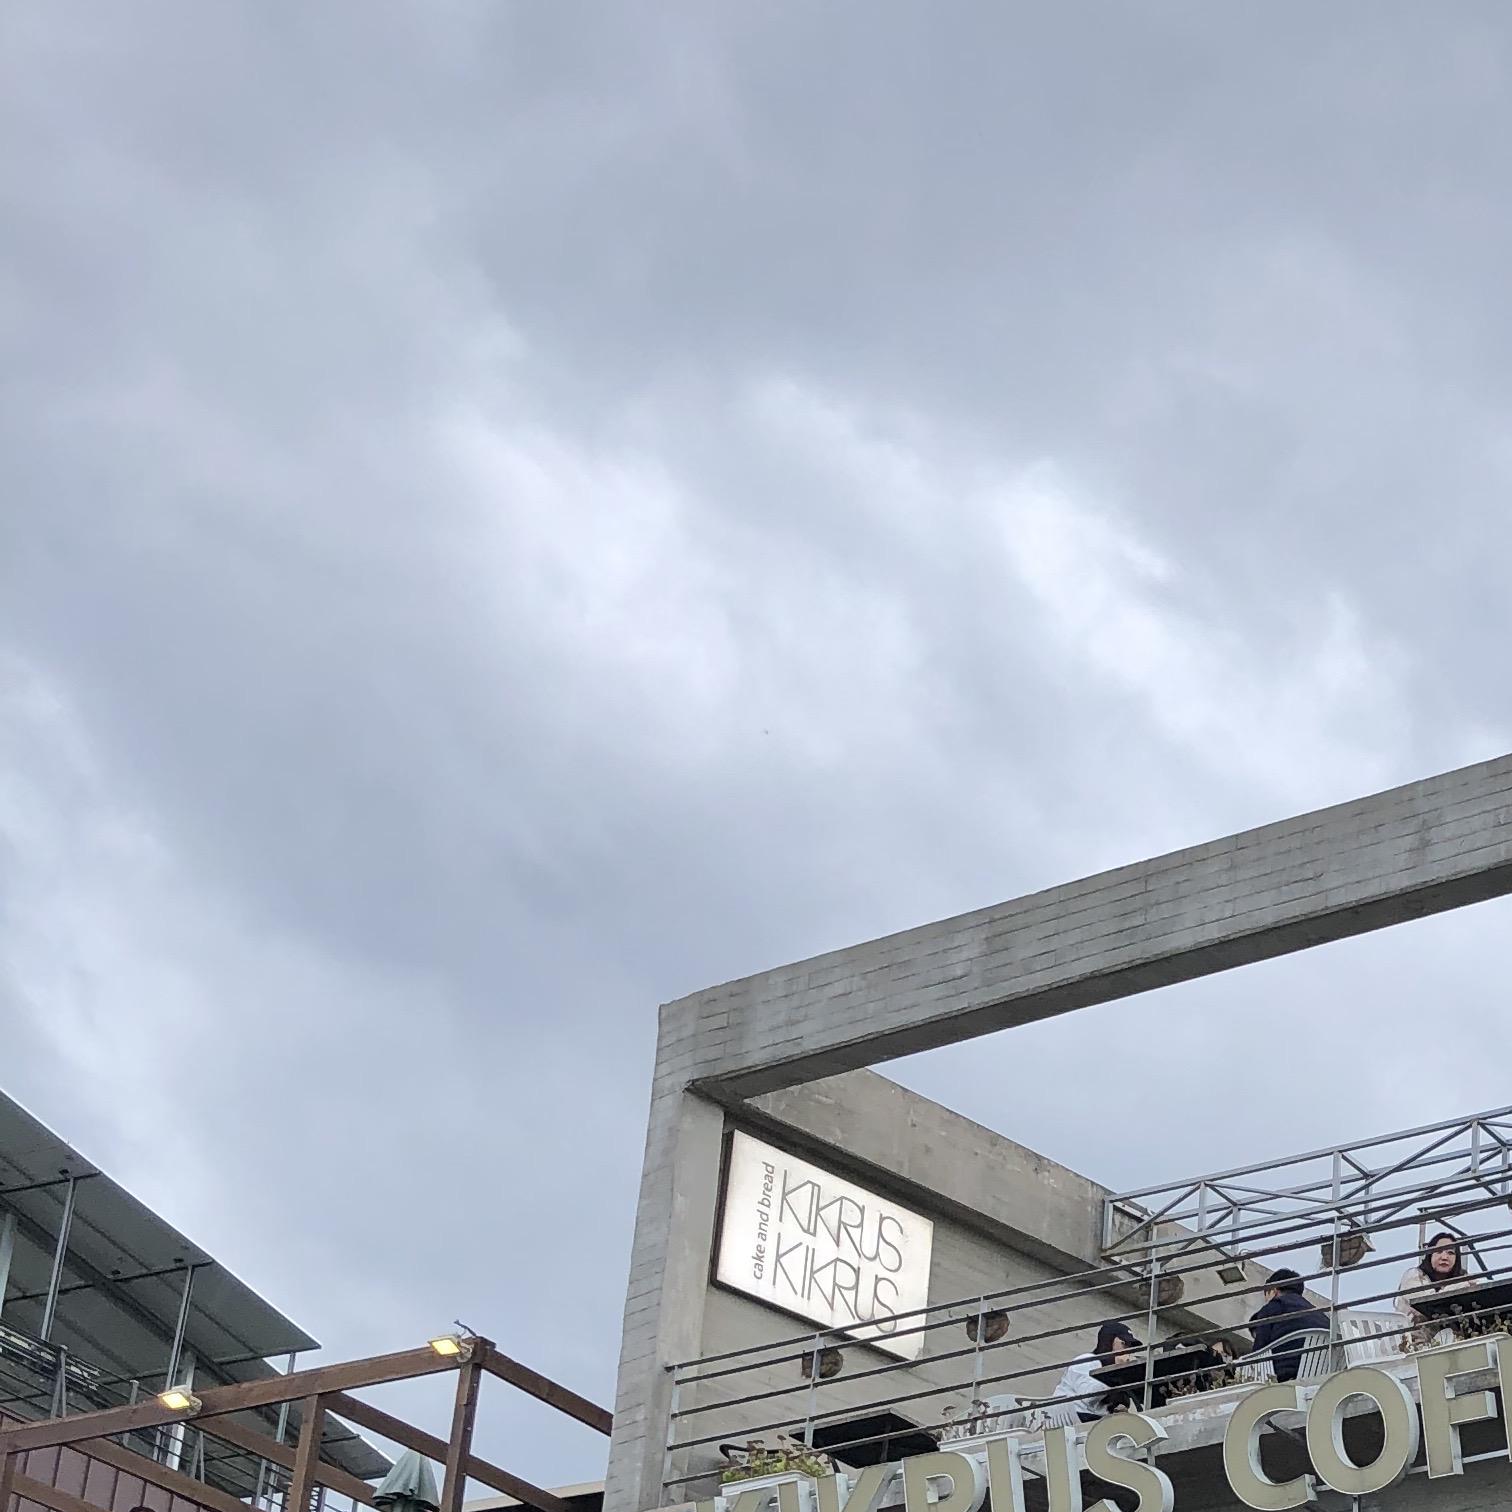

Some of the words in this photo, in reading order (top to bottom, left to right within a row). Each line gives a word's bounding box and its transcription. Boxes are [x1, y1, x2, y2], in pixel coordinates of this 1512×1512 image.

[758, 1161, 775, 1209] bread
[757, 1209, 770, 1241] and
[779, 1169, 903, 1273] KIKRUS
[752, 1243, 766, 1280] cake
[772, 1232, 899, 1333] KIKRUS
